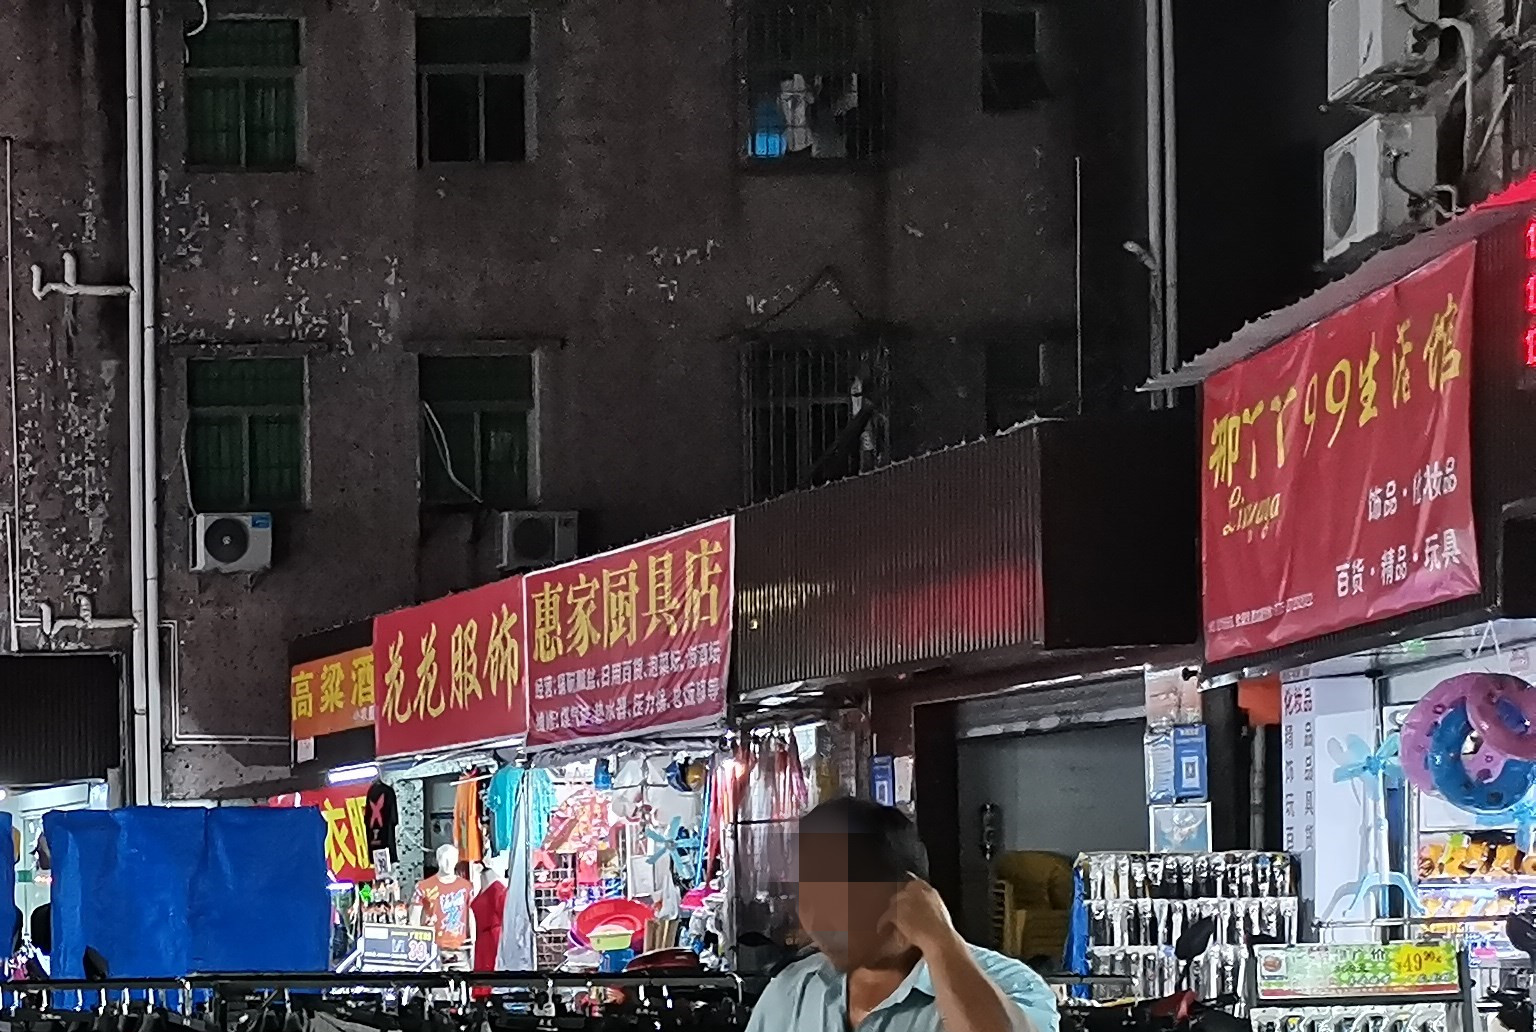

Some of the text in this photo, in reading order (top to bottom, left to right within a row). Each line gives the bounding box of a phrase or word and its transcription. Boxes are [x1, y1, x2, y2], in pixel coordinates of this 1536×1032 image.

[532, 538, 724, 664] 惠家厨具店
[381, 602, 520, 726] 花花服饰
